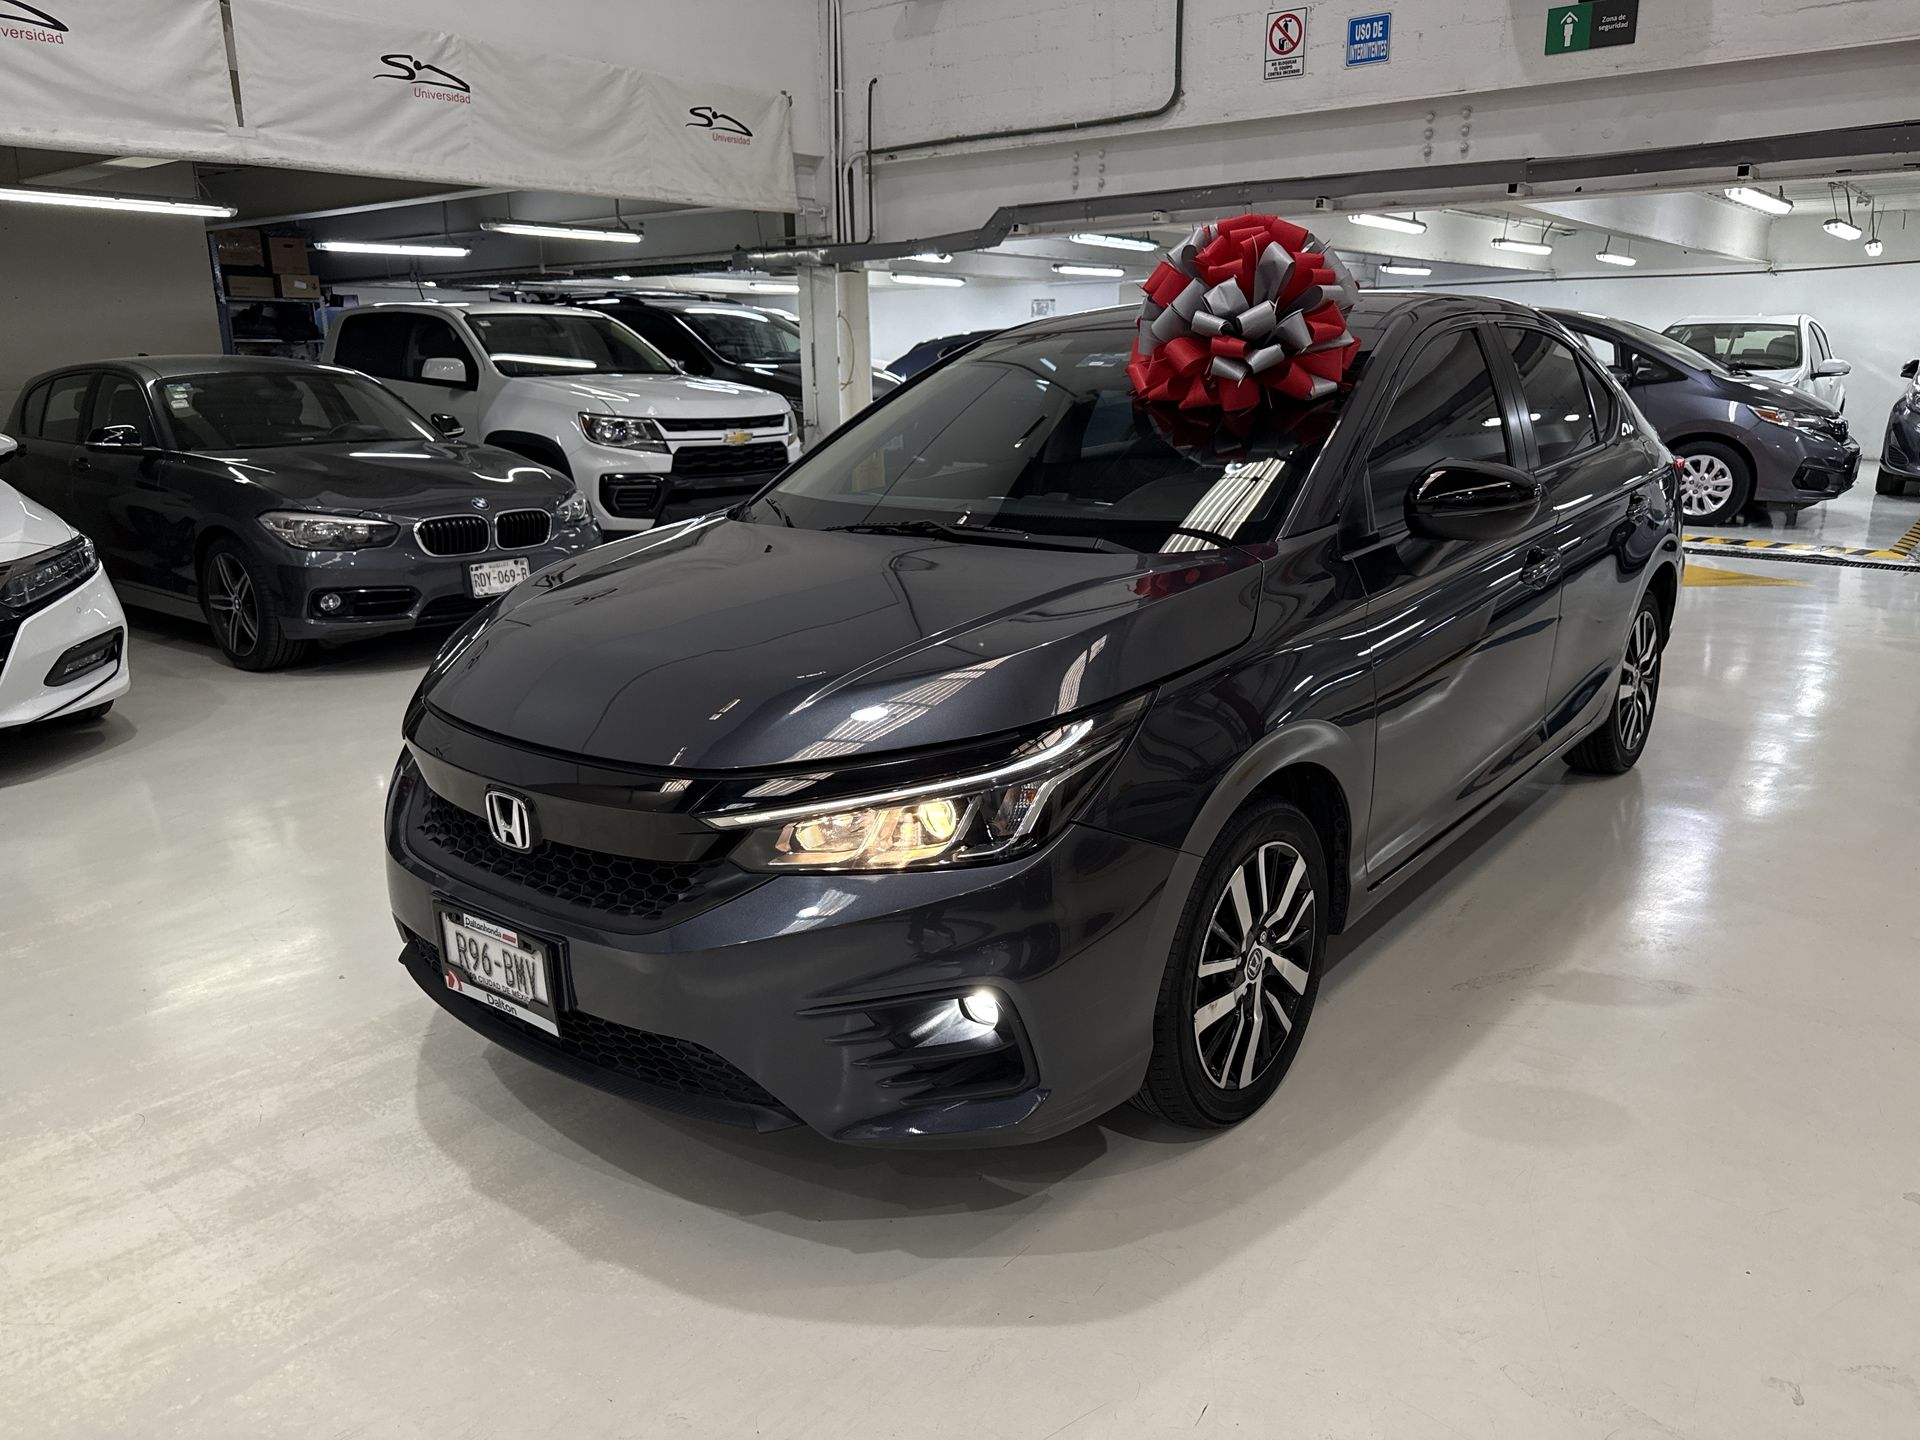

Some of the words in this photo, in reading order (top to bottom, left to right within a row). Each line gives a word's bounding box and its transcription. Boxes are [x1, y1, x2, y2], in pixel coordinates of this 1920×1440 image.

[1618, 13, 1627, 21] de
[1355, 22, 1371, 41] USO
[1372, 20, 1384, 39] DE
[1598, 21, 1629, 31] seguridad
[0, 27, 65, 45] versidad
[413, 87, 471, 104] Universidad
[712, 132, 751, 145] Universidad
[478, 975, 501, 990] CIUDAD
[501, 985, 511, 995] DE
[486, 993, 518, 1016] Dalton
